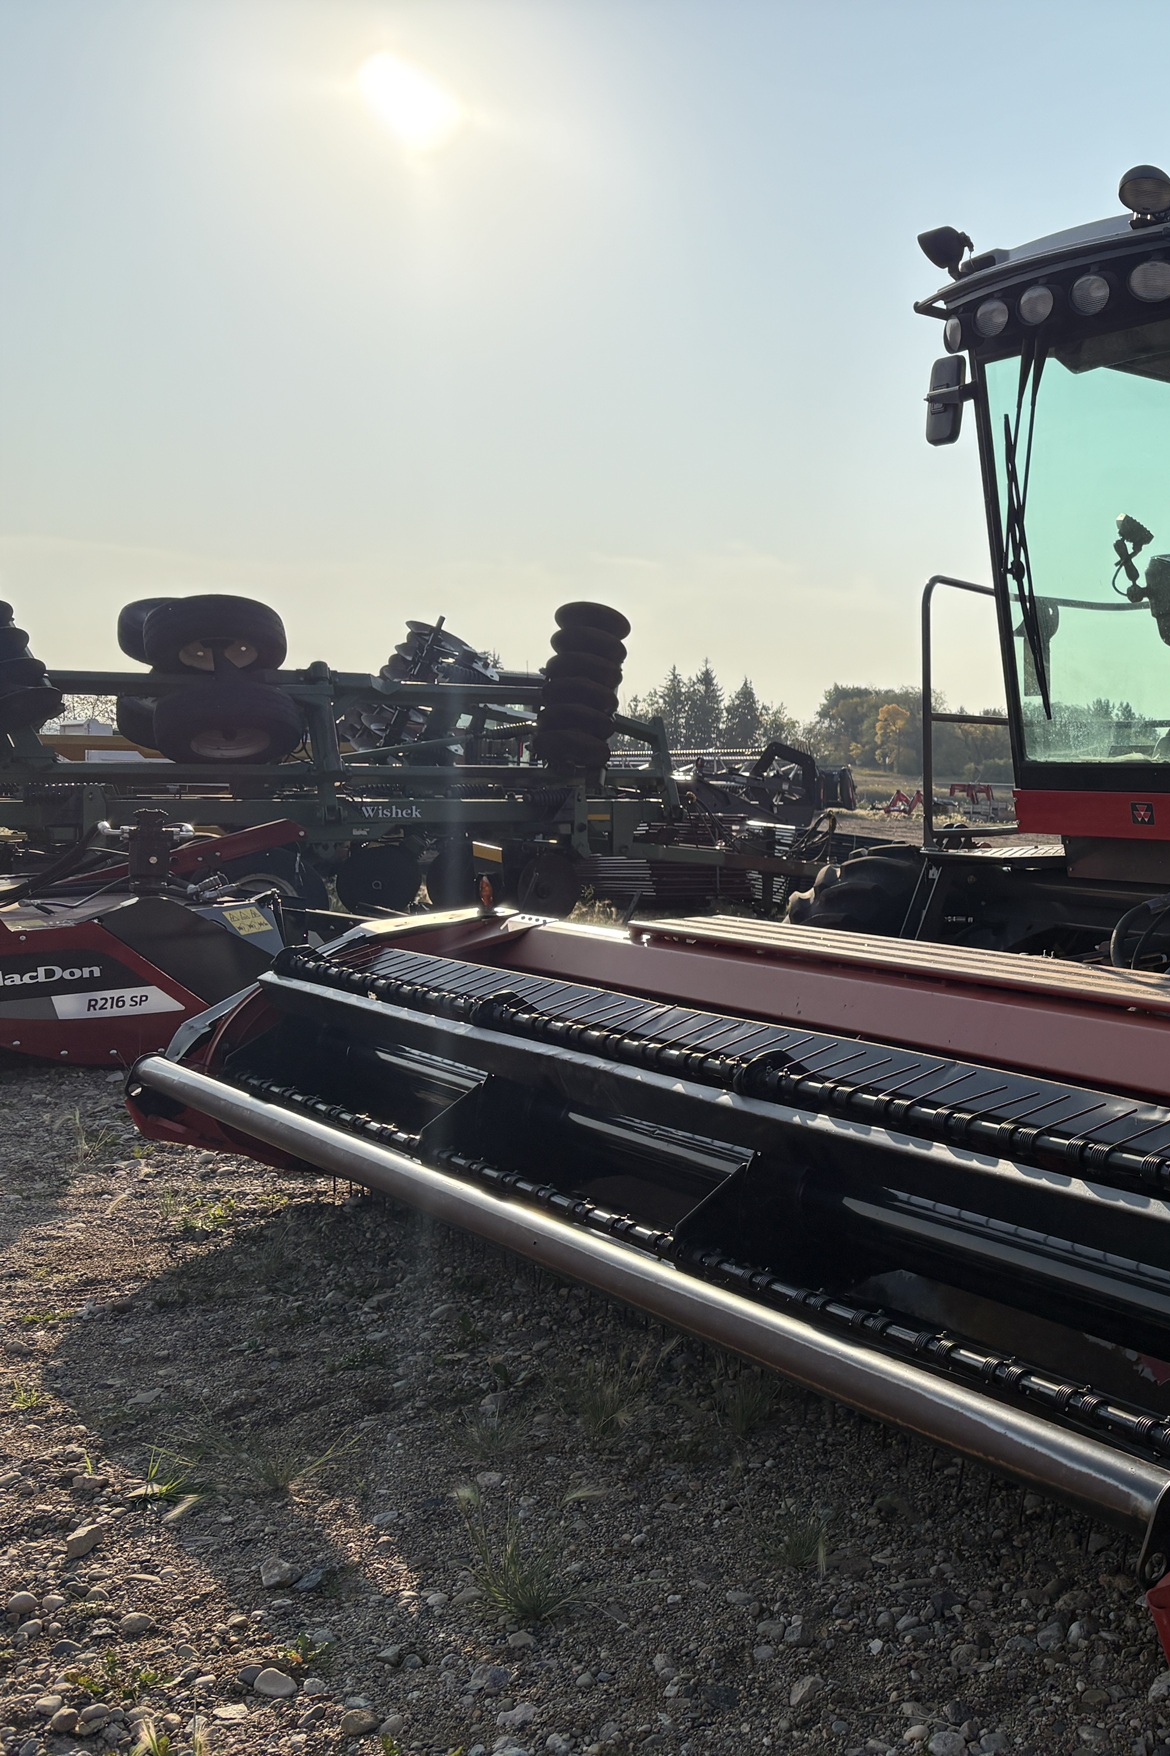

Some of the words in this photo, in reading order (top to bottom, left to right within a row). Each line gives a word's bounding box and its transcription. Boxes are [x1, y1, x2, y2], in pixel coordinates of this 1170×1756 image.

[361, 805, 421, 818] Wishek
[86, 996, 125, 1012] R216
[129, 994, 149, 1007] SP
